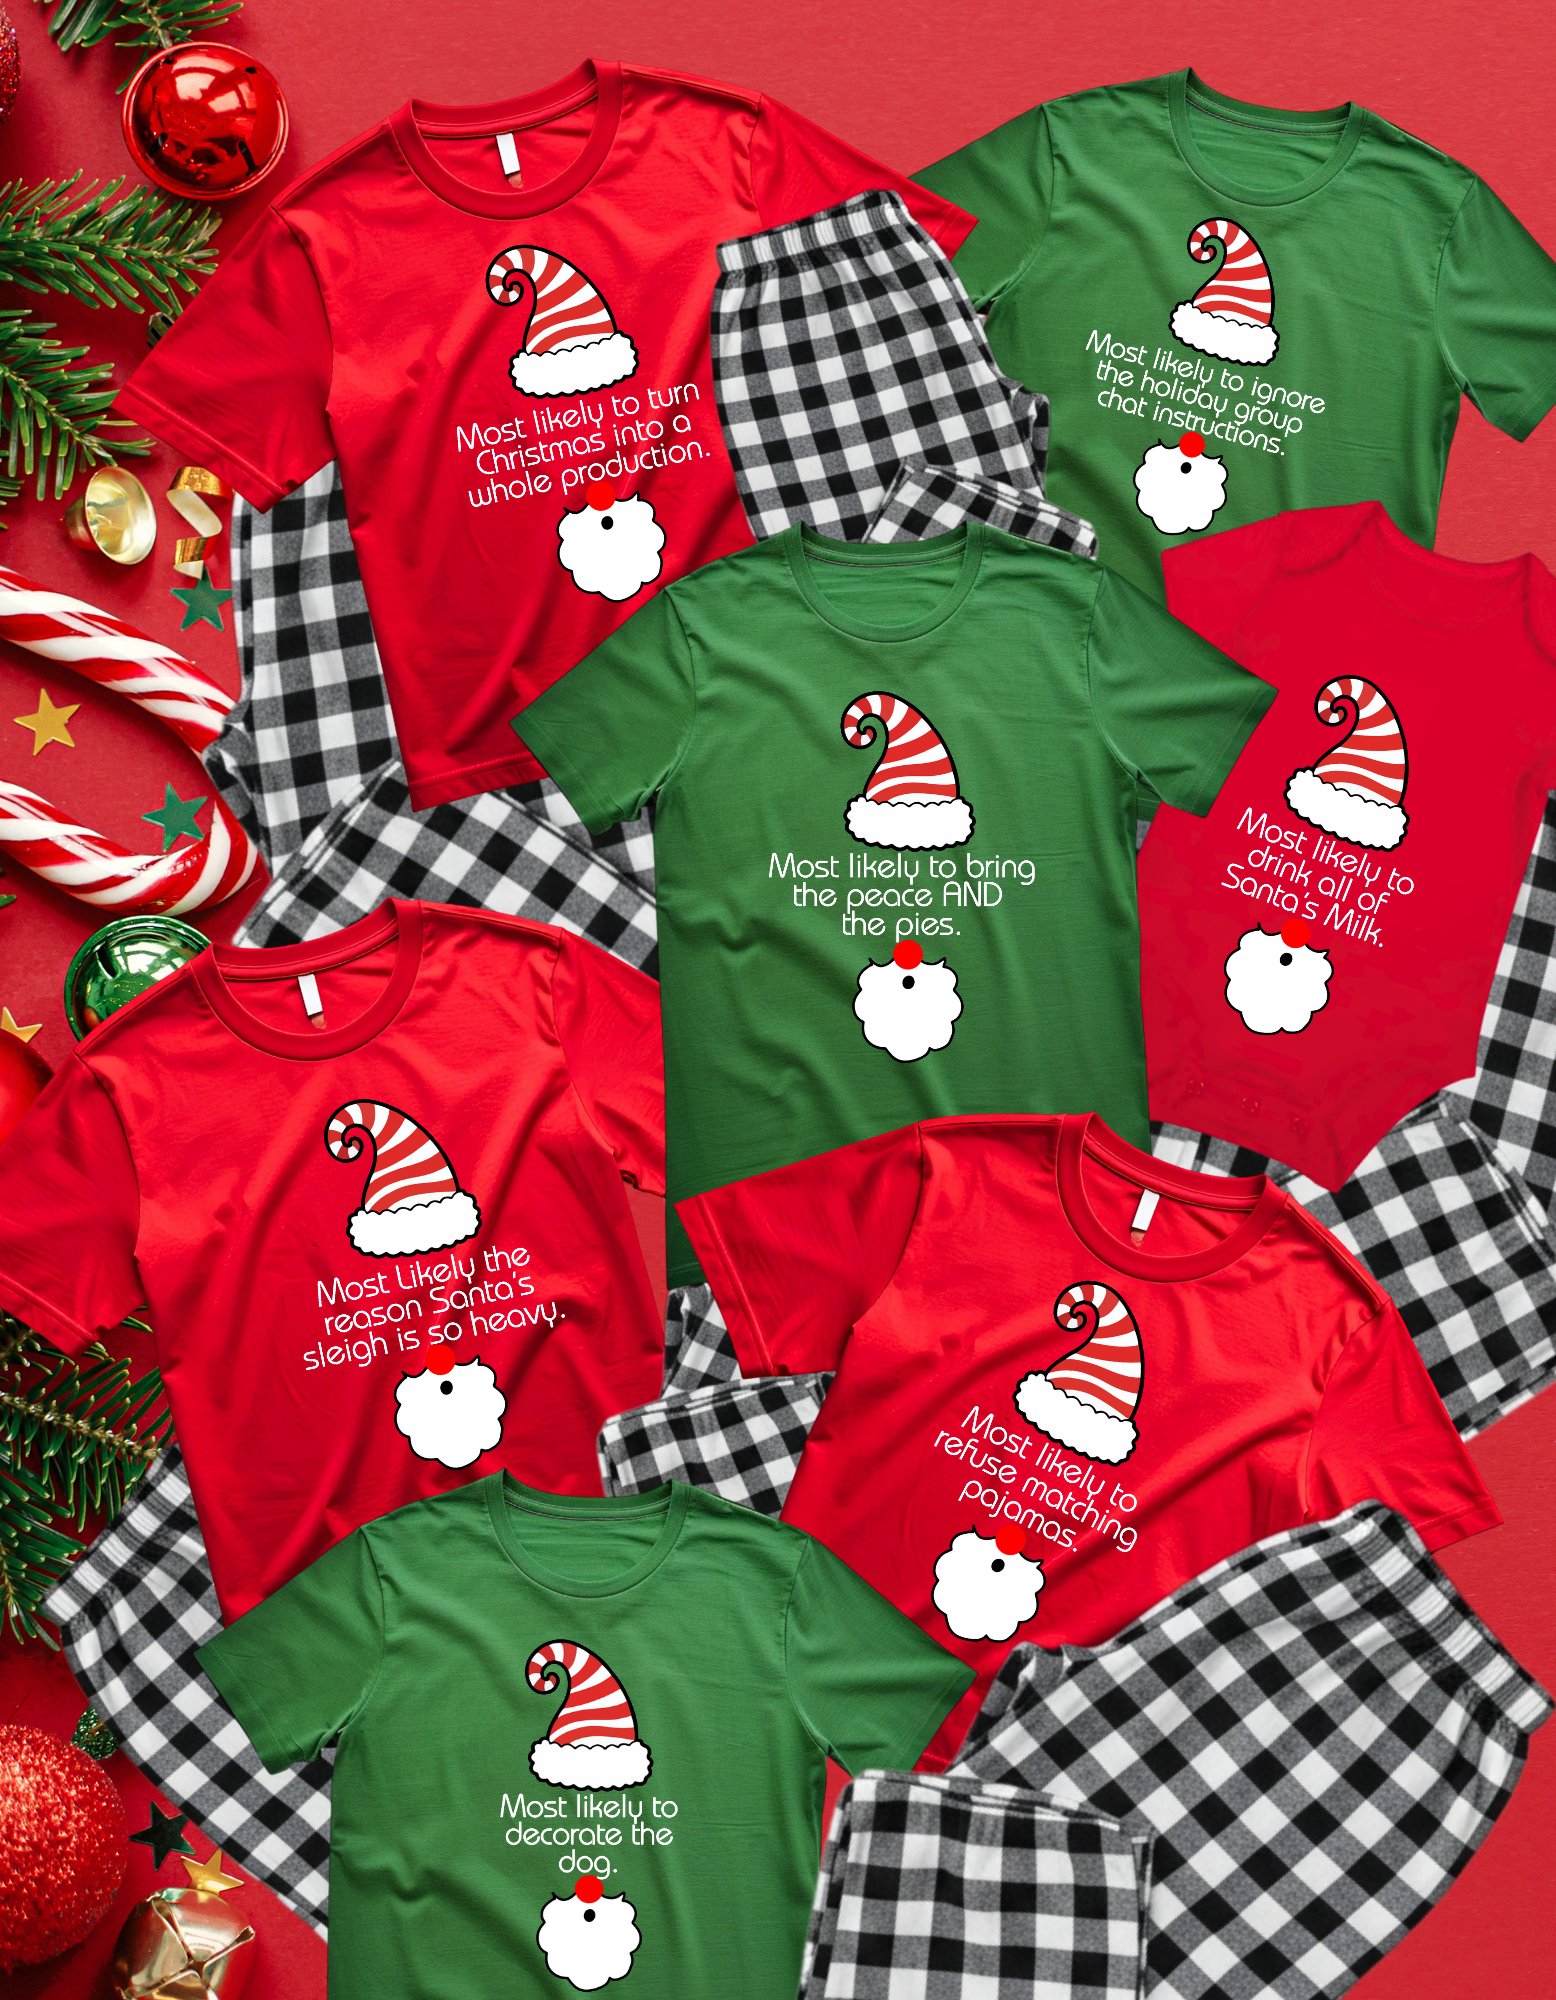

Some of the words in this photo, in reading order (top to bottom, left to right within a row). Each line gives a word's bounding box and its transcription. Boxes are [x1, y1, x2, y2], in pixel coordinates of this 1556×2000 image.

[1085, 329, 1148, 366] Most
[1152, 347, 1215, 389] likely
[1220, 368, 1245, 392] to
[1250, 376, 1326, 414] ignore
[1096, 359, 1135, 387] the
[1139, 369, 1229, 419] holiday
[1233, 402, 1303, 438] group
[456, 417, 528, 453] Most
[532, 399, 604, 435] likely
[611, 395, 640, 417] to
[646, 383, 700, 410] turn
[476, 432, 606, 475] Christmas
[612, 419, 664, 447] into
[672, 414, 692, 433] a
[1097, 386, 1149, 418] chat
[1152, 400, 1285, 456] instructions.
[468, 470, 552, 508] whole
[561, 441, 711, 496] production.
[768, 852, 840, 879] Most
[849, 852, 920, 886] likely
[929, 855, 957, 879] to
[966, 852, 1036, 886] bring
[1236, 806, 1308, 855] Most
[1311, 835, 1382, 888] likely
[1387, 867, 1415, 895] to
[1247, 845, 1313, 888] drink
[1317, 875, 1354, 903] all
[1357, 891, 1391, 915] of
[793, 881, 838, 908] the
[846, 888, 934, 915] peace
[943, 880, 1003, 908] AND
[842, 909, 886, 936] the
[895, 912, 961, 944] pies.
[1220, 863, 1320, 920] Santa's
[1323, 902, 1383, 948] Milk.
[317, 1271, 391, 1308] Most
[395, 1253, 476, 1290] Likely
[483, 1245, 531, 1273] the
[324, 1299, 423, 1336] reason
[429, 1270, 535, 1315] Santa's
[303, 1330, 389, 1371] sleigh
[396, 1327, 421, 1352] is
[427, 1321, 463, 1346] so
[469, 1301, 566, 1337] heavy.
[933, 1430, 1018, 1484] refuse
[1021, 1476, 1138, 1553] matching
[960, 1405, 1033, 1460] Most
[1035, 1442, 1106, 1501] likely
[1109, 1482, 1138, 1513] to
[957, 1480, 1078, 1553] pajamas.
[499, 1792, 568, 1819] Most
[576, 1793, 643, 1825] likely
[652, 1796, 679, 1819] to
[505, 1820, 623, 1846] decorate
[631, 1820, 674, 1846] the
[558, 1848, 618, 1881] dog.
